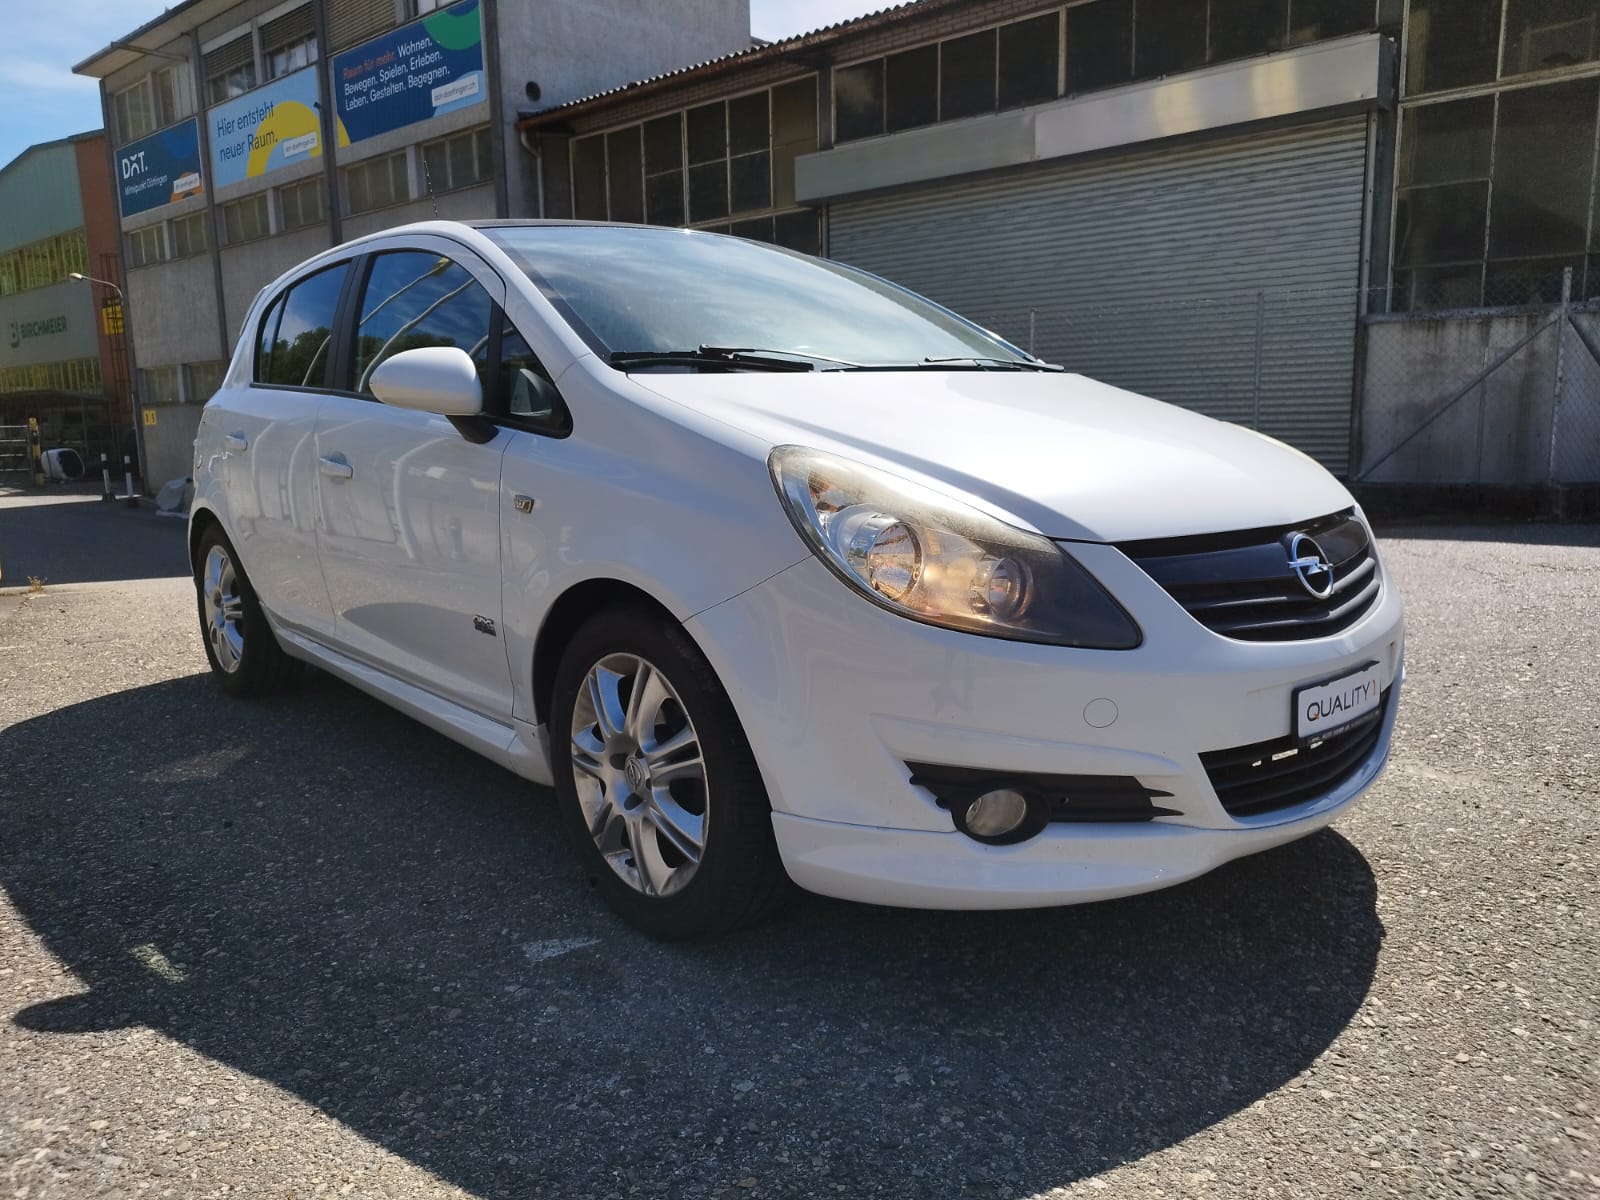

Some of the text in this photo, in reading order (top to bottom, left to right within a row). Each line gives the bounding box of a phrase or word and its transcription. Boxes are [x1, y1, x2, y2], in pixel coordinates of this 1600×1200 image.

[397, 37, 433, 58] Wohnen.
[344, 51, 443, 96] Bewegen. Spielen. Erleben.
[345, 66, 450, 111] Leben. Gestalten. Begegnen.
[216, 101, 275, 138] Hier entsteht
[220, 141, 247, 162] neuer
[248, 130, 279, 152] Raum.
